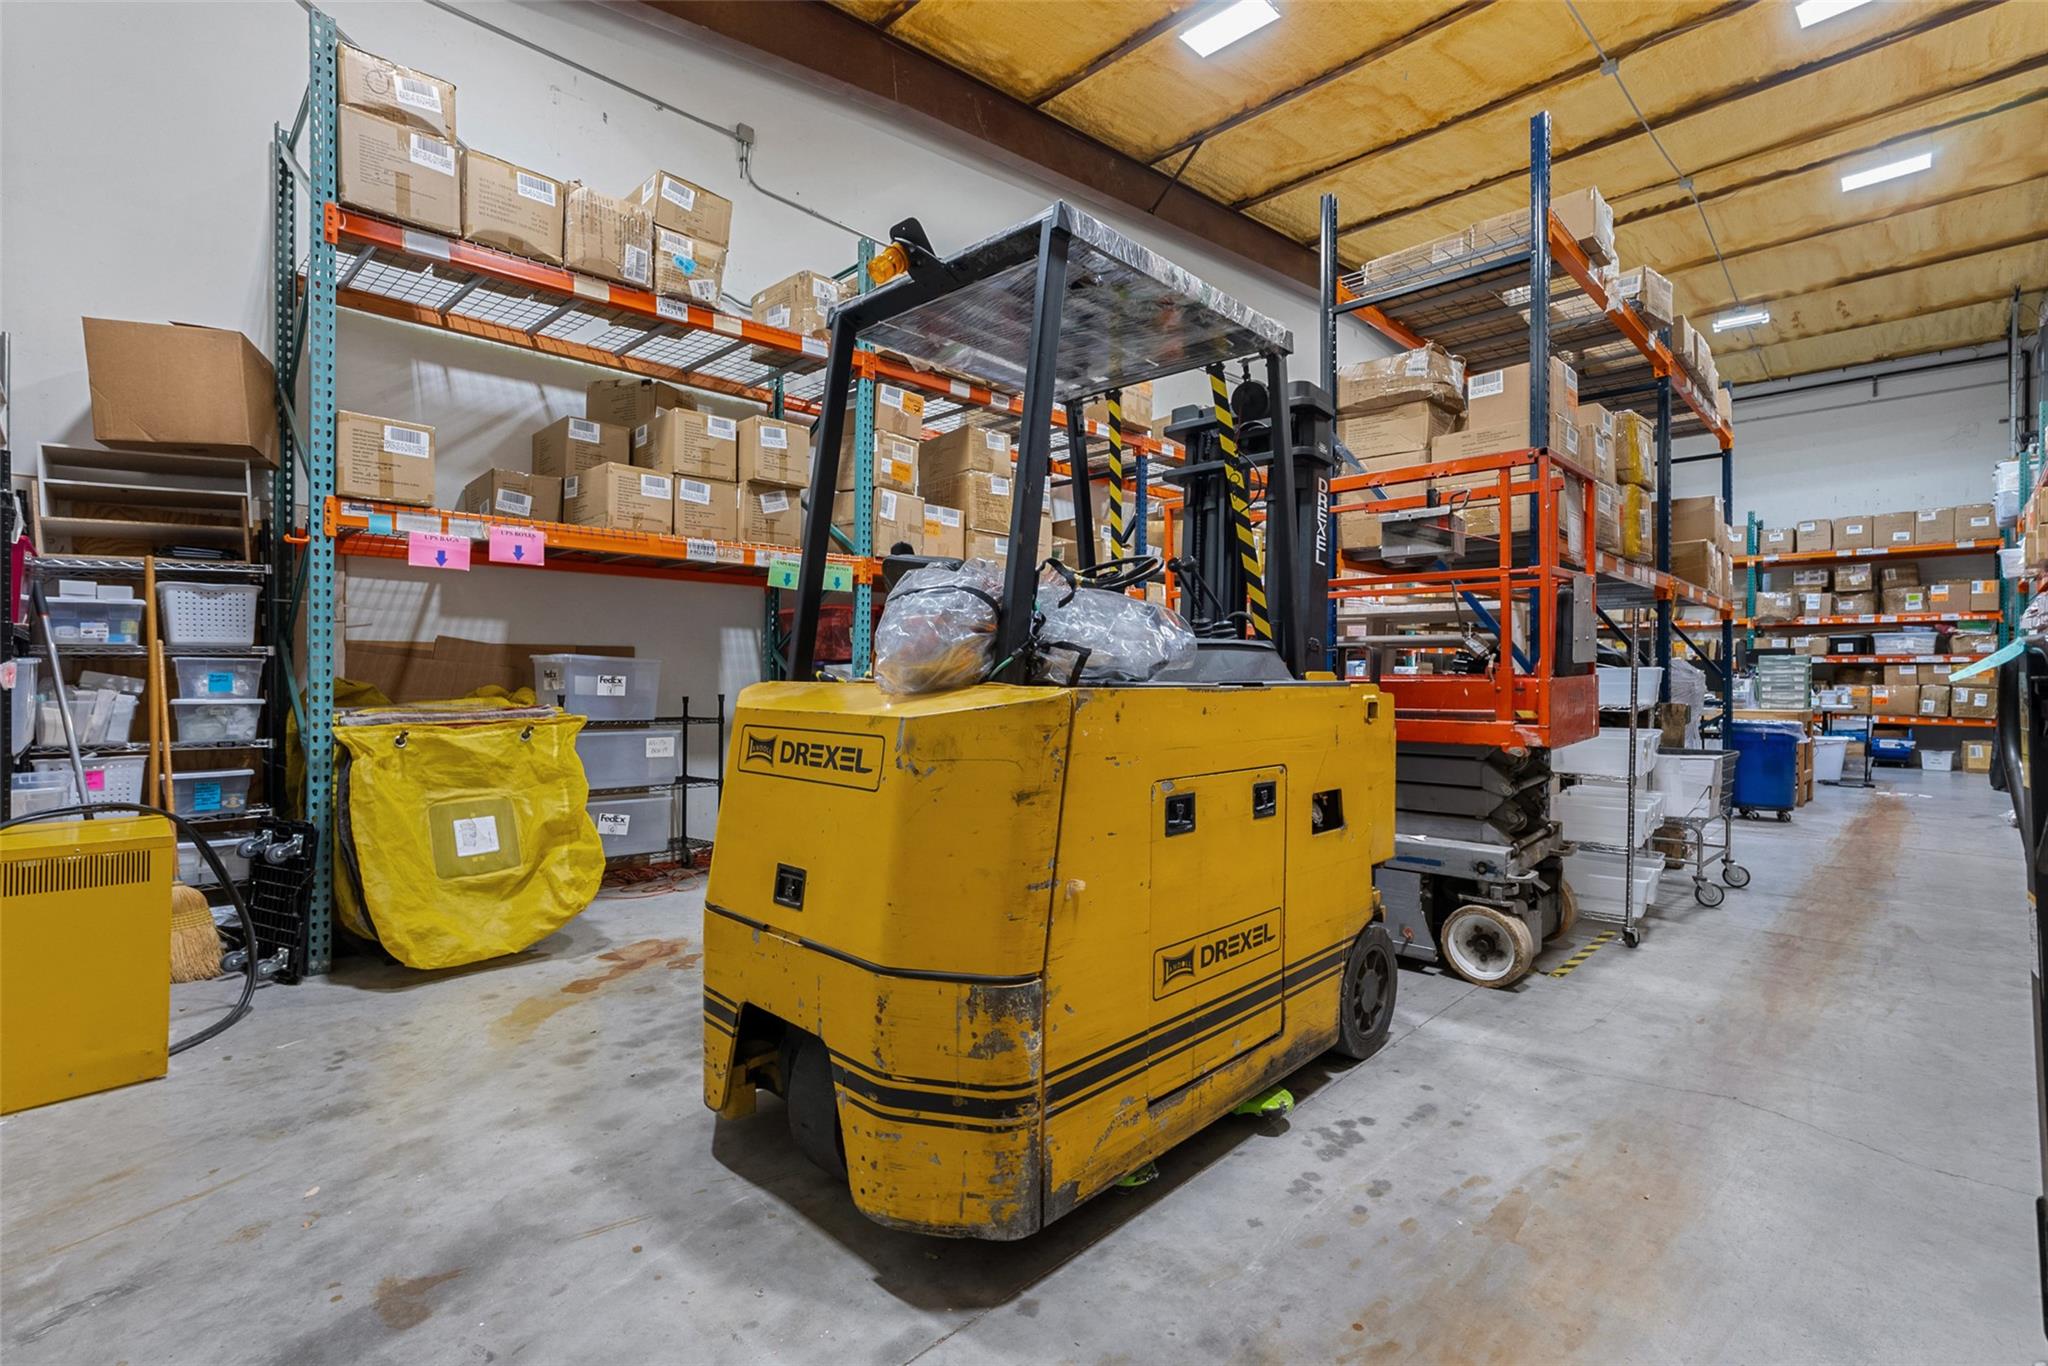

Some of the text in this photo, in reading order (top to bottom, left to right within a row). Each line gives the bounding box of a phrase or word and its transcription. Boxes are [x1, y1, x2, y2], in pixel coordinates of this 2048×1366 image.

[1315, 477, 1328, 566] DREXEL
[599, 675, 623, 684] FedEx
[780, 740, 873, 774] DREXEL
[600, 814, 626, 823] FedEx
[1200, 923, 1276, 969] DREXEL
